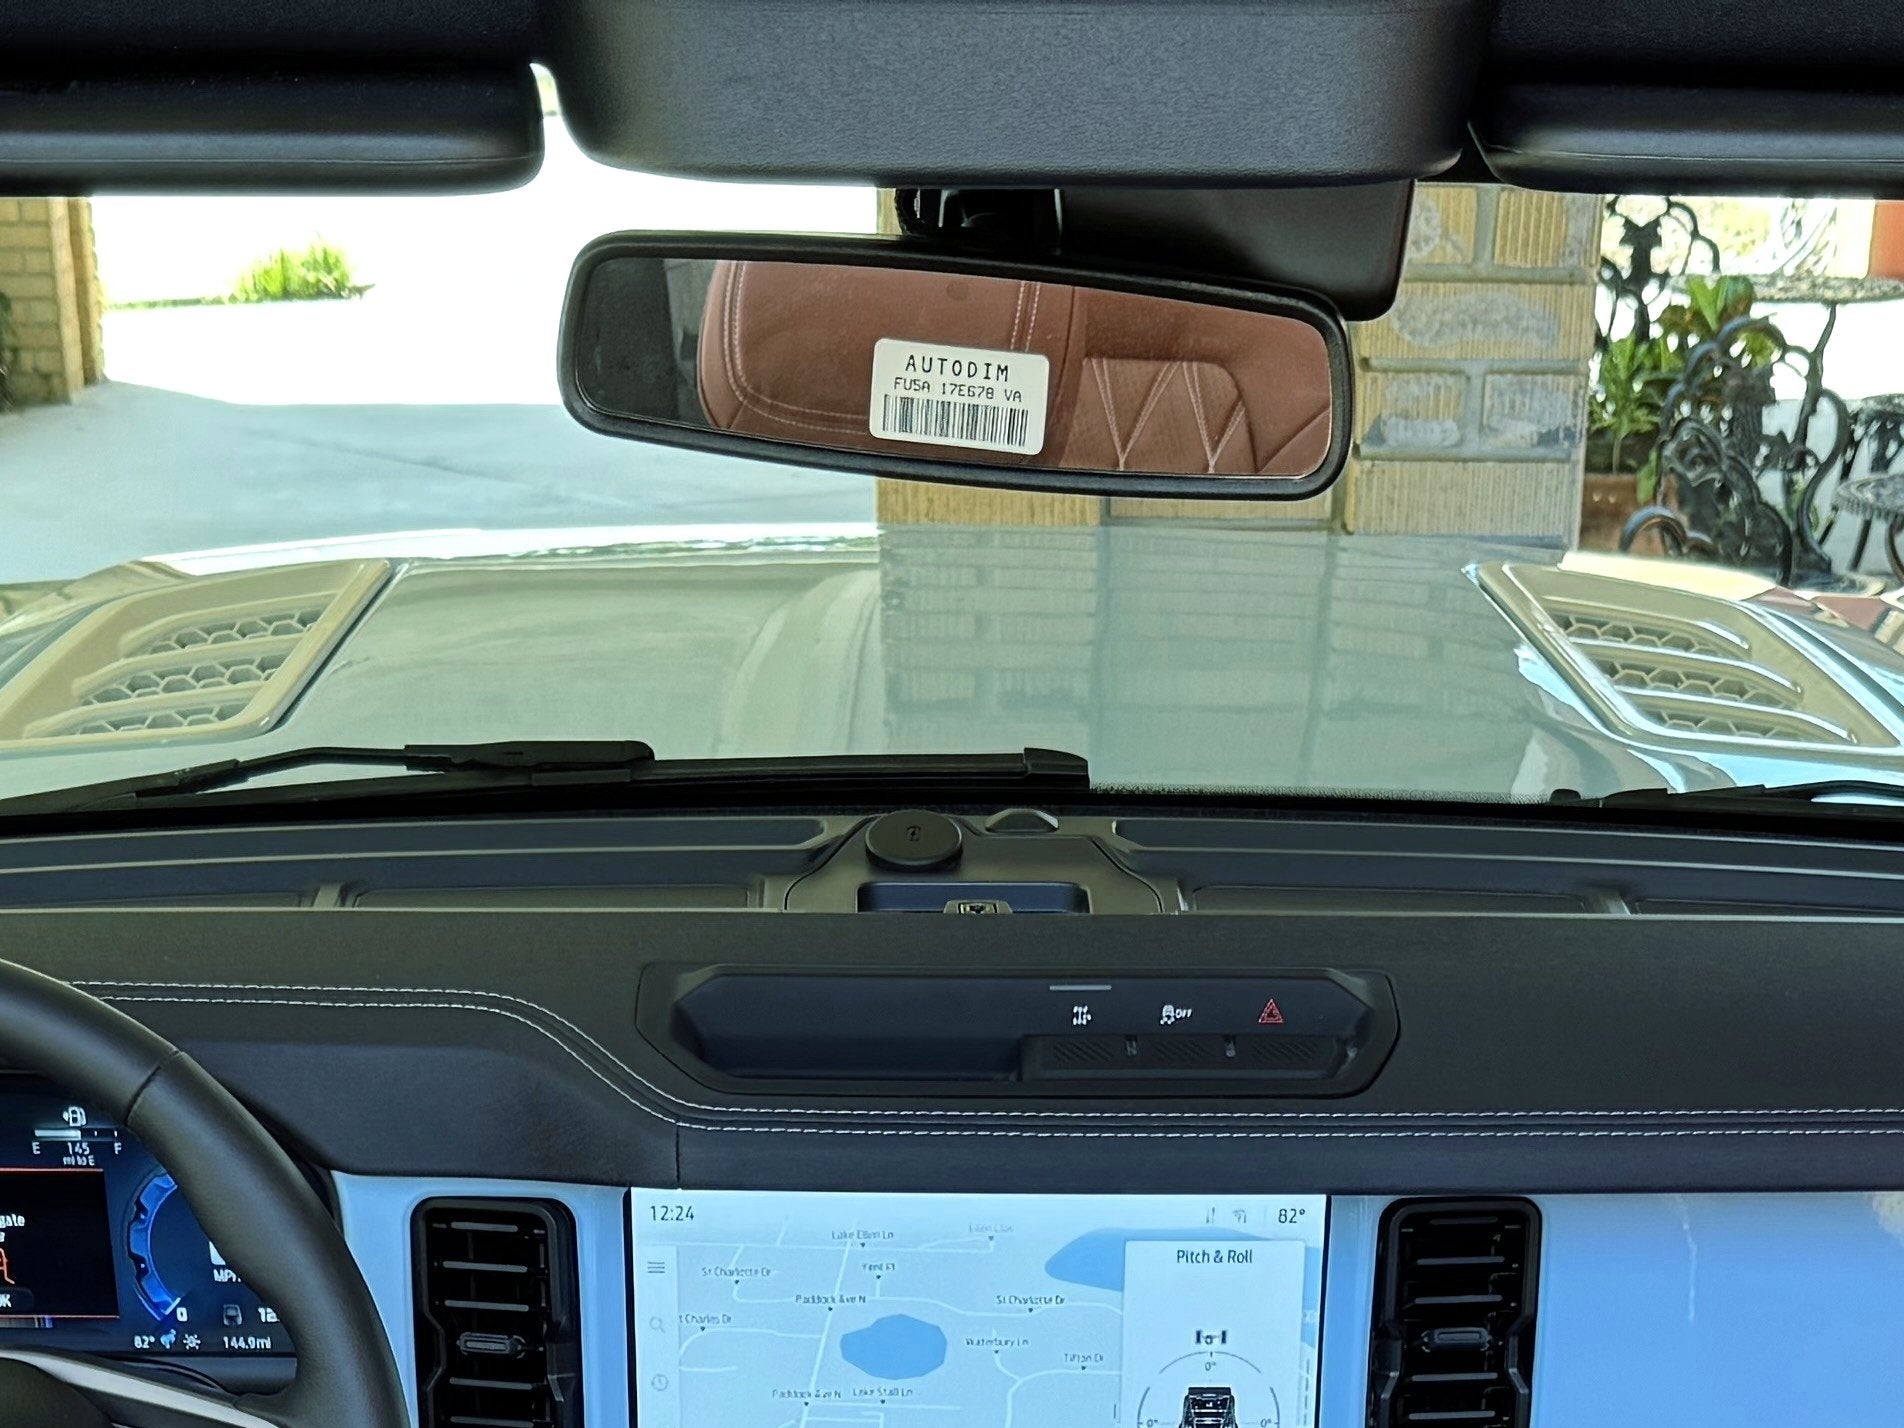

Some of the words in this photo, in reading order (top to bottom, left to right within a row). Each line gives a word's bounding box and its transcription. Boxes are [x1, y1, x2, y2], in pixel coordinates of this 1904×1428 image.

[905, 354, 1009, 382] AUTODIM
[894, 377, 930, 392] FU5A
[942, 383, 994, 399] 17E678
[1004, 389, 1022, 402] VA
[32, 1142, 41, 1154] E
[67, 1143, 90, 1155] 145
[114, 1142, 122, 1155] F
[650, 1205, 695, 1221] 12:24
[1277, 1208, 1306, 1224] 82°
[1176, 1249, 1211, 1265] Pitch
[1214, 1250, 1224, 1264] &
[1227, 1249, 1253, 1265] Roll
[176, 1307, 188, 1322] 0
